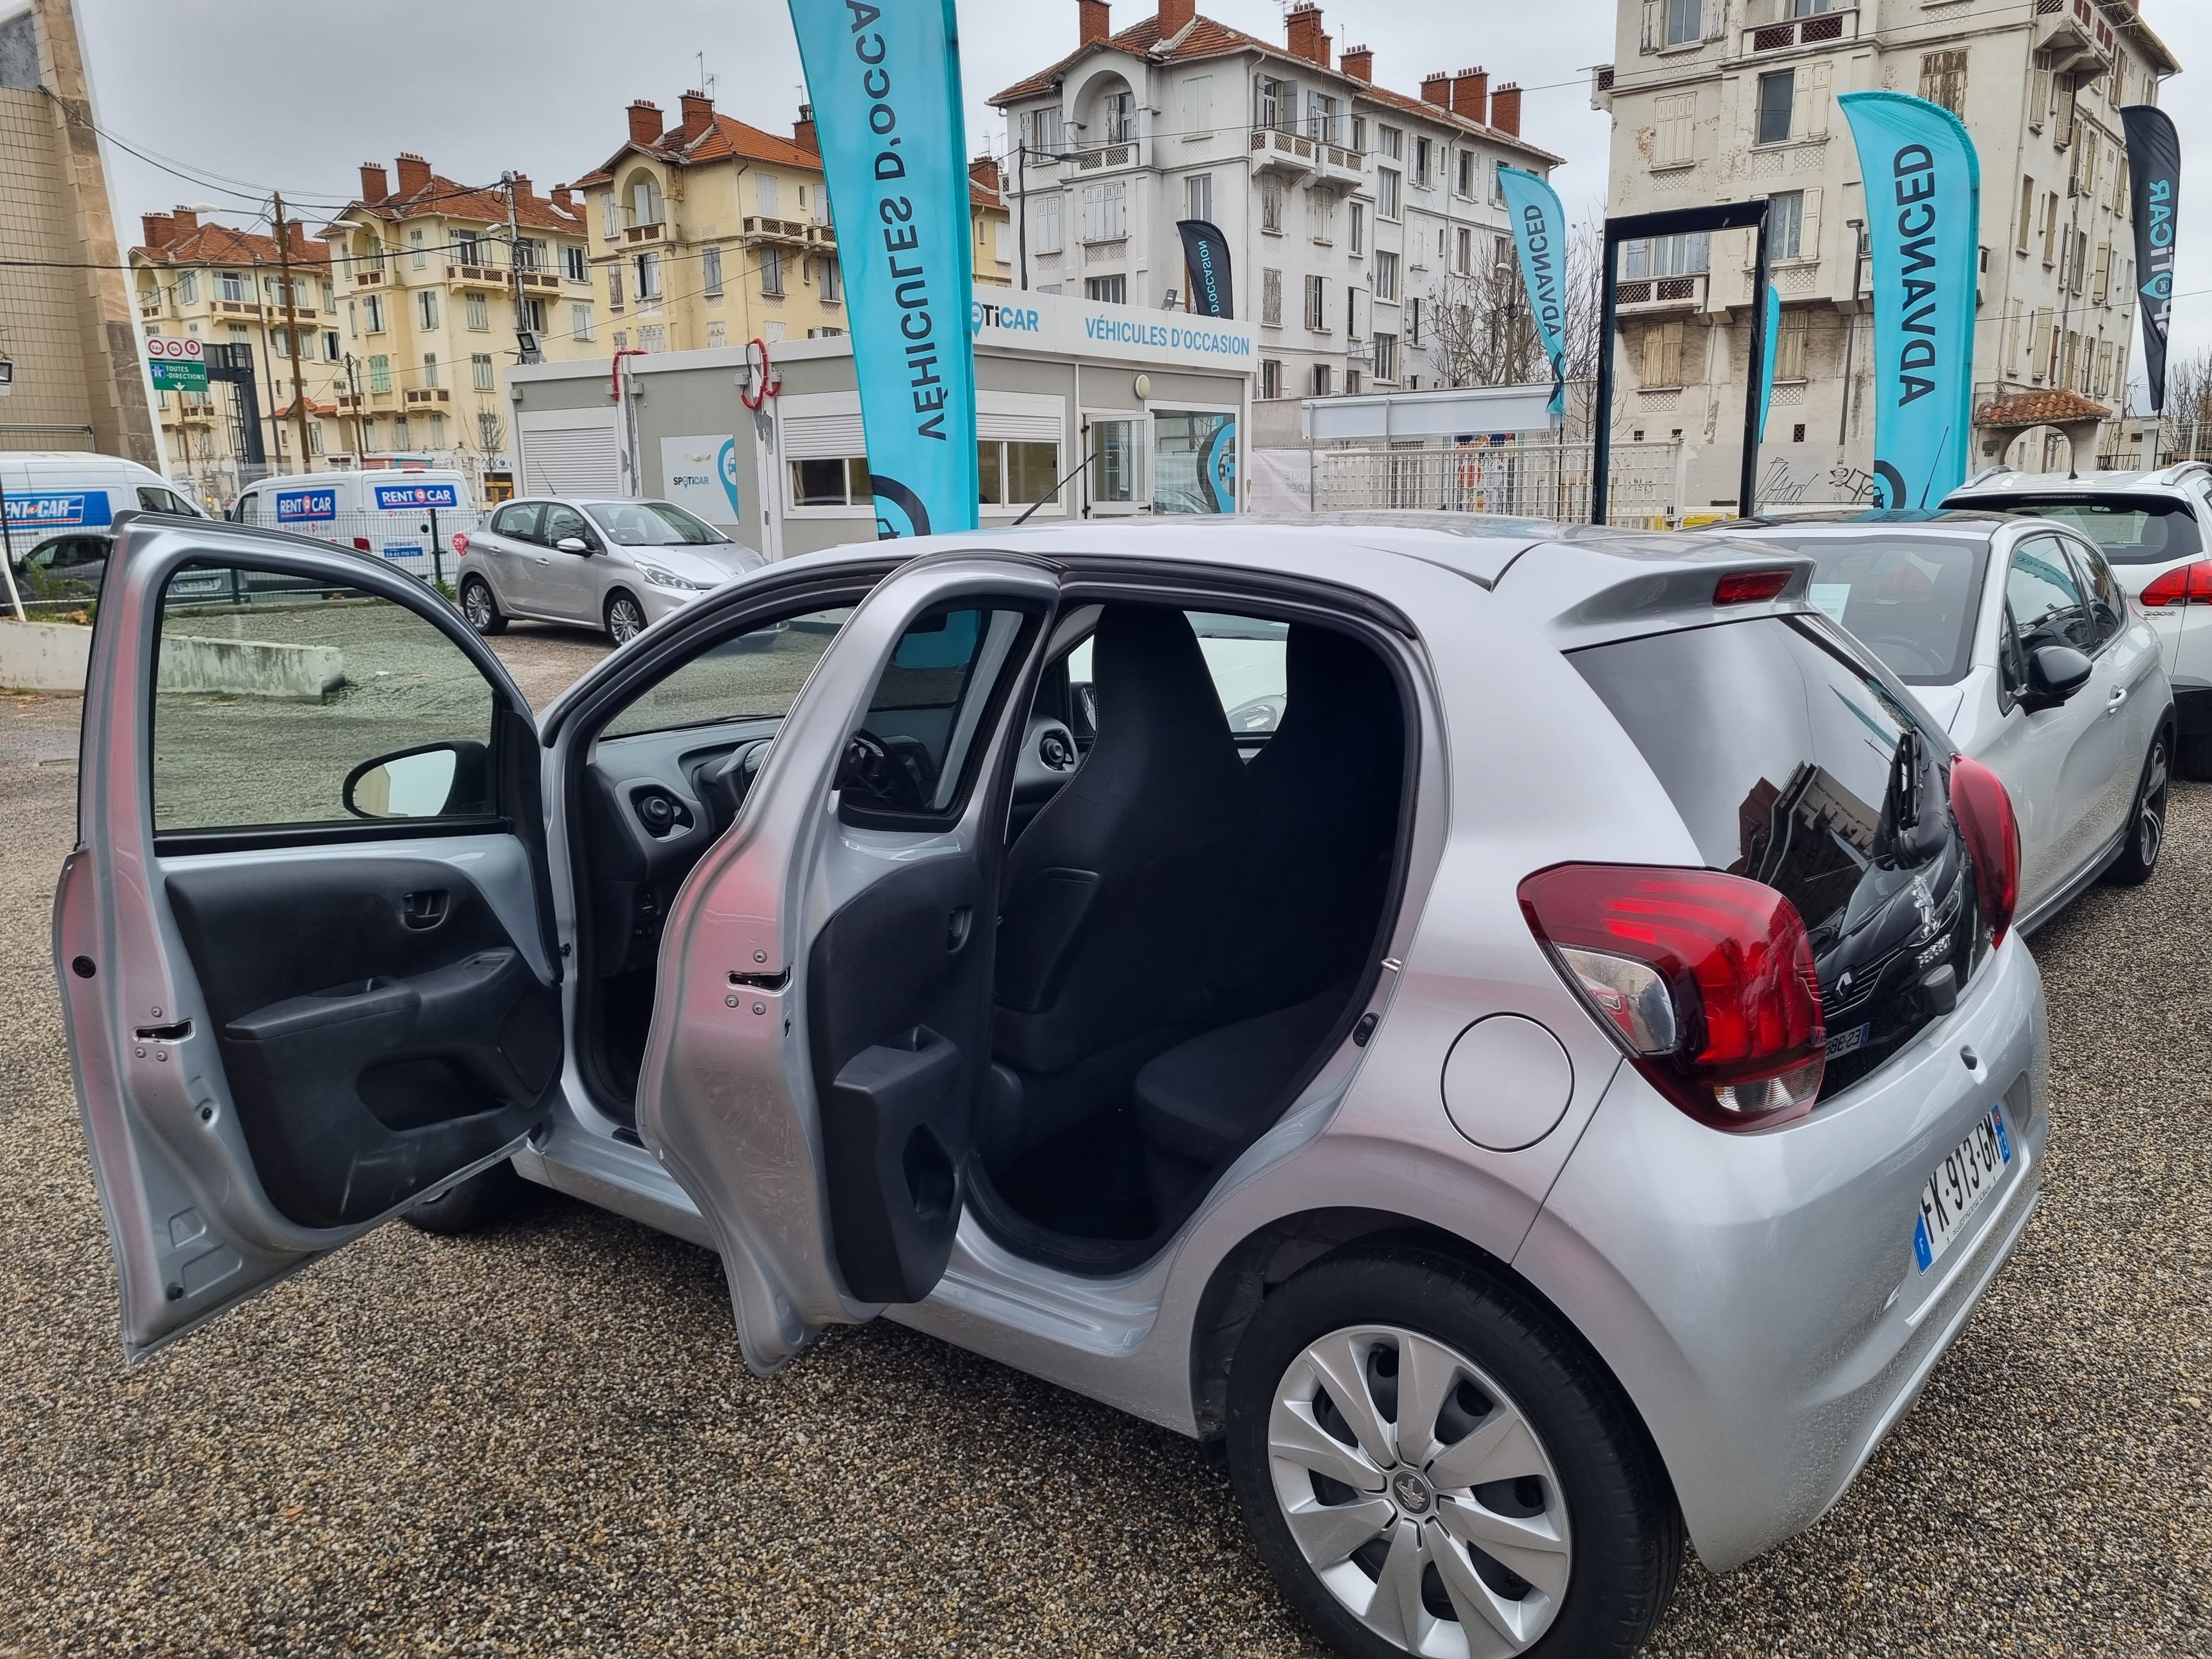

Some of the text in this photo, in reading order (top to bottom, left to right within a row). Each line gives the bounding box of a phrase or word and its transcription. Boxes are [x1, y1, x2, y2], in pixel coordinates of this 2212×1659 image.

[1085, 314, 1250, 356] VÉHICULES D'OCCASION
[280, 499, 302, 514] RENT
[312, 496, 331, 511] CAR
[381, 490, 414, 503] RENT
[427, 489, 452, 500] CAR
[38, 500, 69, 517] CAR
[1921, 1113, 2000, 1245] FK-913-GM
[1999, 1131, 2008, 1158] 13
